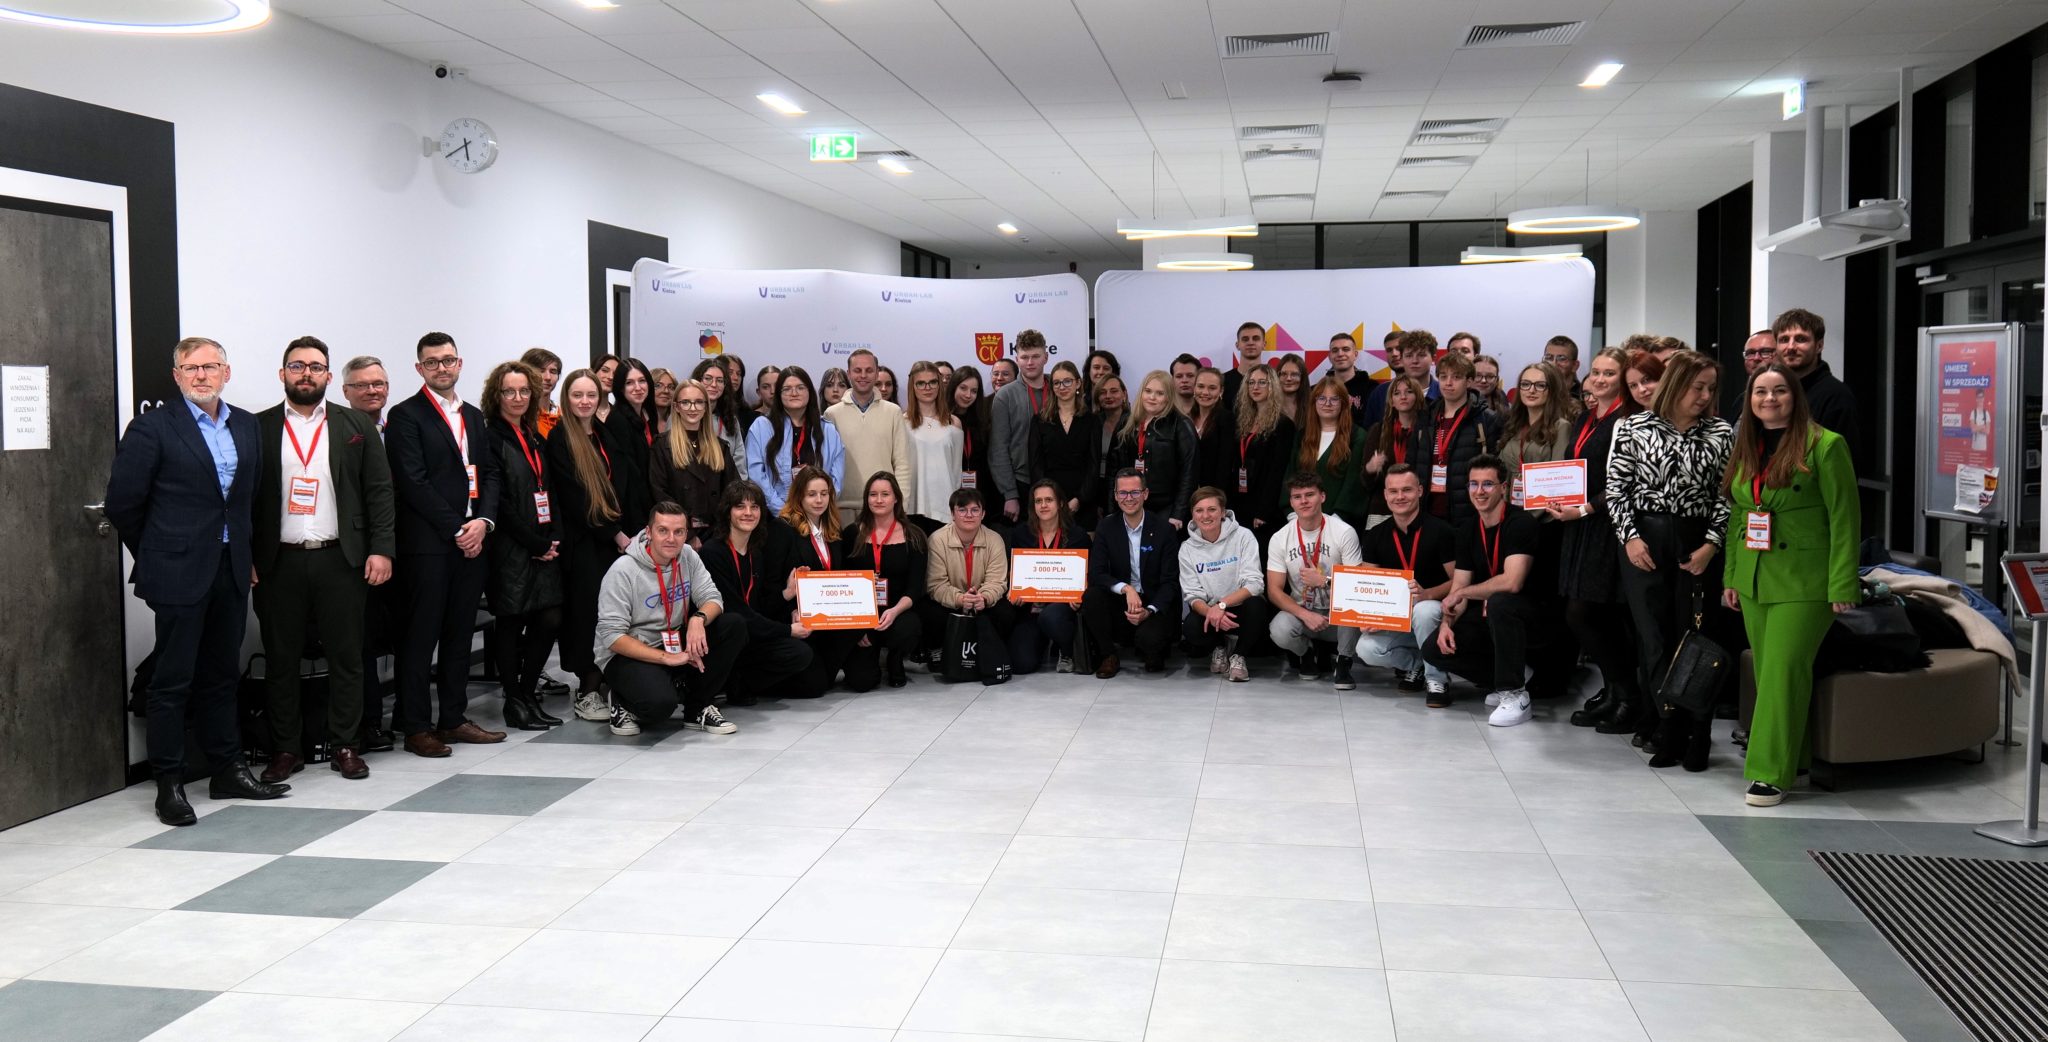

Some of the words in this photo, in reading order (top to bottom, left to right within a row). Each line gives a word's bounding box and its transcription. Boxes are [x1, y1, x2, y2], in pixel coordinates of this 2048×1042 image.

[979, 346, 998, 362] CK
[1944, 364, 1968, 373] UMIESZ
[1945, 378, 1951, 387] W
[1952, 376, 1989, 386] SPRZEDAŻ?
[1374, 588, 1389, 596] PLN
